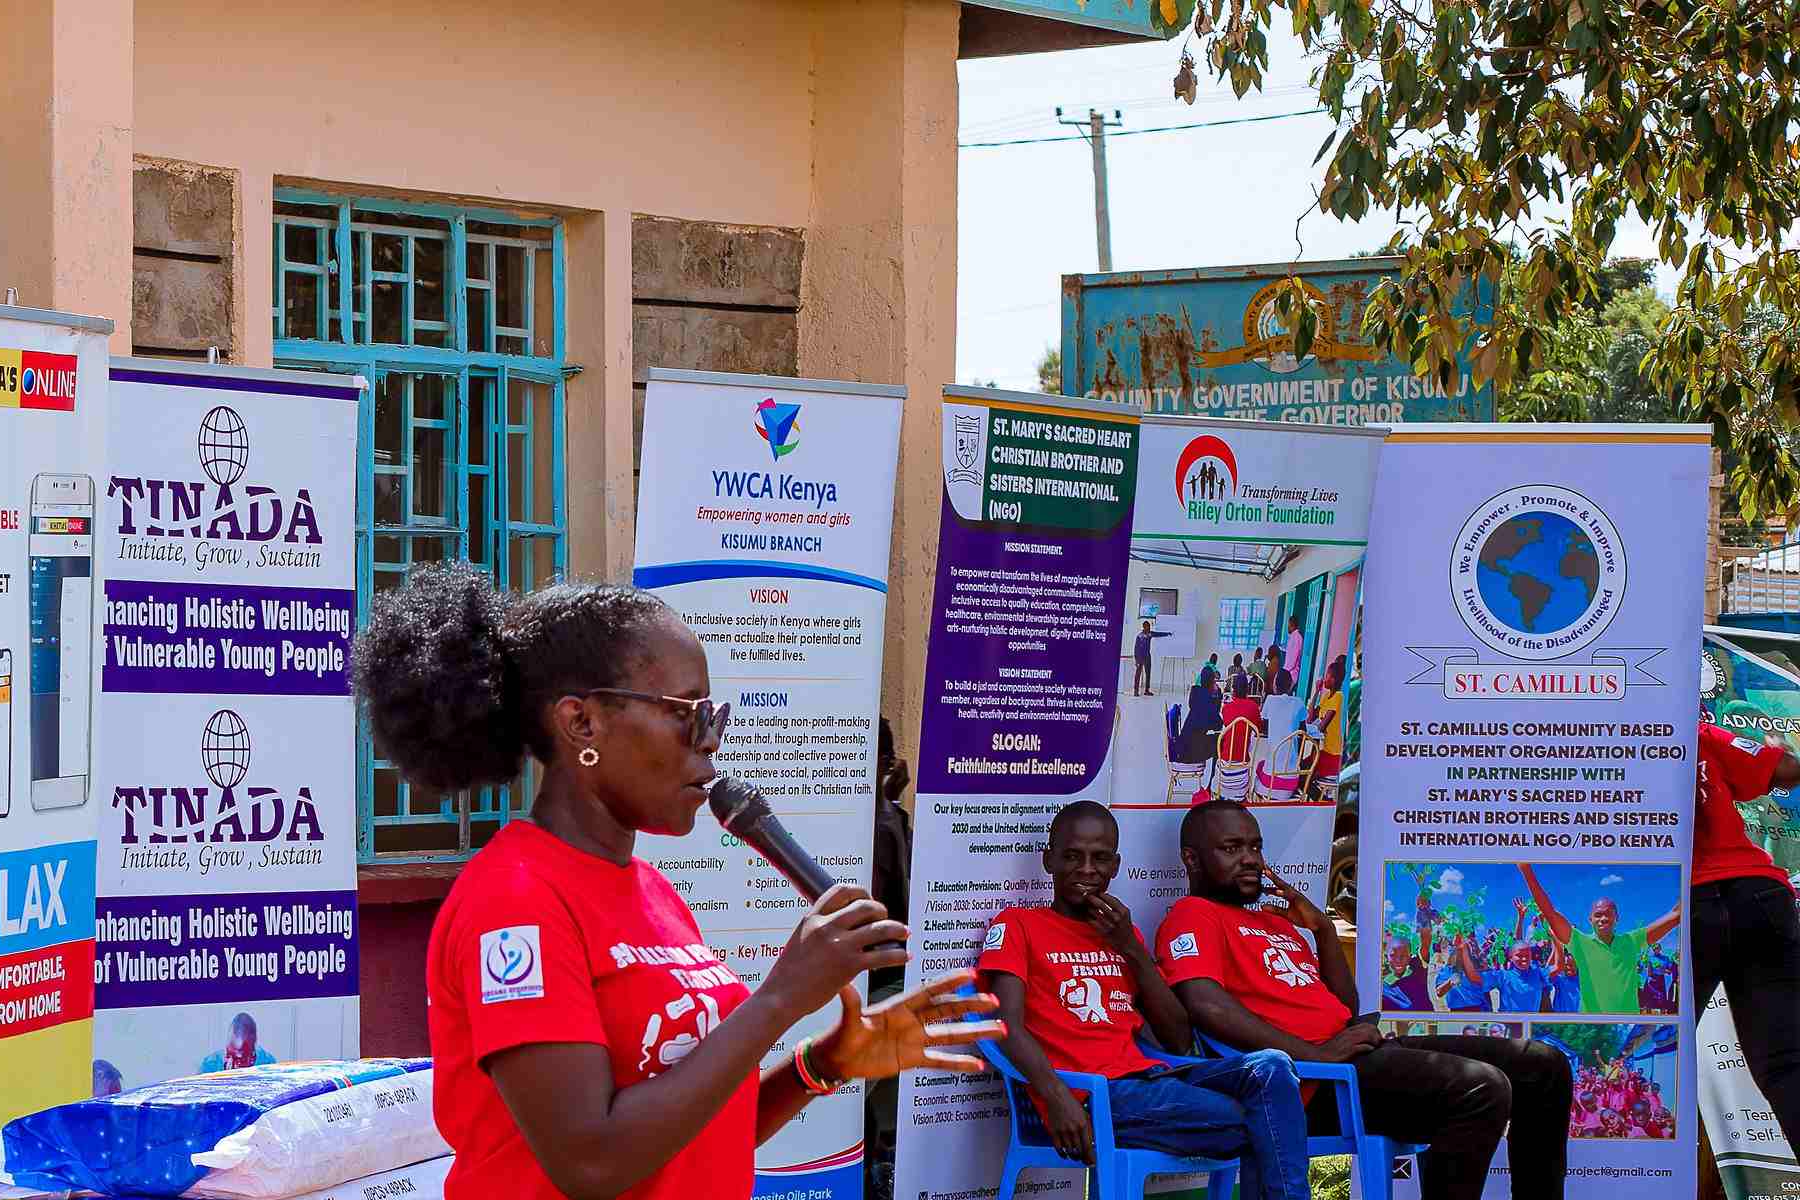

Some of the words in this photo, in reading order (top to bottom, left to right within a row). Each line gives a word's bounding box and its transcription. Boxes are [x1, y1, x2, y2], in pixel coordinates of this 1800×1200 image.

[22, 367, 76, 399] ONLINE
[1084, 386, 1181, 412] COUNTY
[1193, 379, 1342, 409] GOVERNMENT
[1352, 377, 1377, 398] OF
[1286, 402, 1405, 425] GOVERNOR
[993, 418, 1010, 436] ST.
[1011, 419, 1053, 441] MARY'S
[1053, 424, 1096, 444] SACRED
[1097, 429, 1132, 449] HEART
[991, 446, 1049, 467] CHRISTIAN
[1051, 451, 1100, 471] BROTHER
[1100, 456, 1124, 475] AND
[712, 470, 774, 500] YWCA
[778, 474, 837, 509] Kenya
[990, 473, 1034, 494] SISTERS
[1240, 483, 1308, 504] Transforming
[1311, 488, 1338, 503] Lives
[107, 476, 323, 545] TINADA
[697, 506, 762, 526] Empowering
[764, 511, 803, 525] women
[806, 511, 828, 525] and
[829, 511, 851, 528] girls
[989, 500, 1022, 523] (NGO)
[1187, 500, 1221, 525] Riley
[1225, 501, 1263, 524] Orton
[1266, 503, 1335, 526] Foundation
[1520, 494, 1578, 514] Promote
[1579, 509, 1590, 521] &
[1464, 501, 1511, 554] Empower
[118, 537, 187, 567] Initiate,
[255, 545, 322, 568] Sustain
[721, 533, 767, 551] KISUMU
[770, 535, 822, 552] BRANCH
[1588, 518, 1616, 574] Improve
[1459, 555, 1472, 575] We
[750, 588, 789, 604] VISION
[185, 597, 255, 630] Holistic
[261, 600, 349, 638] Wellbeing
[1463, 588, 1506, 642] Livelihood
[1508, 636, 1523, 649] of
[1523, 638, 1544, 650] the
[1545, 588, 1614, 649] Disadvantaged
[114, 636, 215, 670] Vulnerable
[220, 638, 275, 677] Young
[282, 639, 344, 678] People
[1455, 673, 1486, 694] ST.
[1492, 673, 1618, 694] CAMILLUS
[740, 692, 788, 708] MISSION
[992, 733, 1041, 751] SLOGAN:
[1400, 722, 1424, 737] ST.
[1427, 723, 1509, 737] CAMILLUS
[1512, 723, 1617, 737] COMMUNITY
[1620, 723, 1674, 737] BASED
[1385, 744, 1504, 759] DEVELOPMENT
[1509, 745, 1637, 759] ORGANIZATION
[1640, 745, 1687, 761] (CBO)
[947, 757, 1008, 775] Faithfulness
[1010, 758, 1030, 775] and
[1031, 759, 1086, 776] Excellence
[1447, 767, 1464, 780] IN
[1467, 767, 1578, 781] PARTNERSHIP
[1581, 768, 1626, 781] WITH
[112, 786, 324, 845] TINADA
[120, 846, 191, 871] Initiate,
[258, 842, 323, 868] Sustain
[189, 906, 258, 940] Holistic
[264, 904, 353, 940] Wellbeing
[117, 949, 219, 982] Vulnerable
[224, 947, 278, 983] Young
[285, 944, 346, 980] People
[29, 990, 61, 1018] HOME
